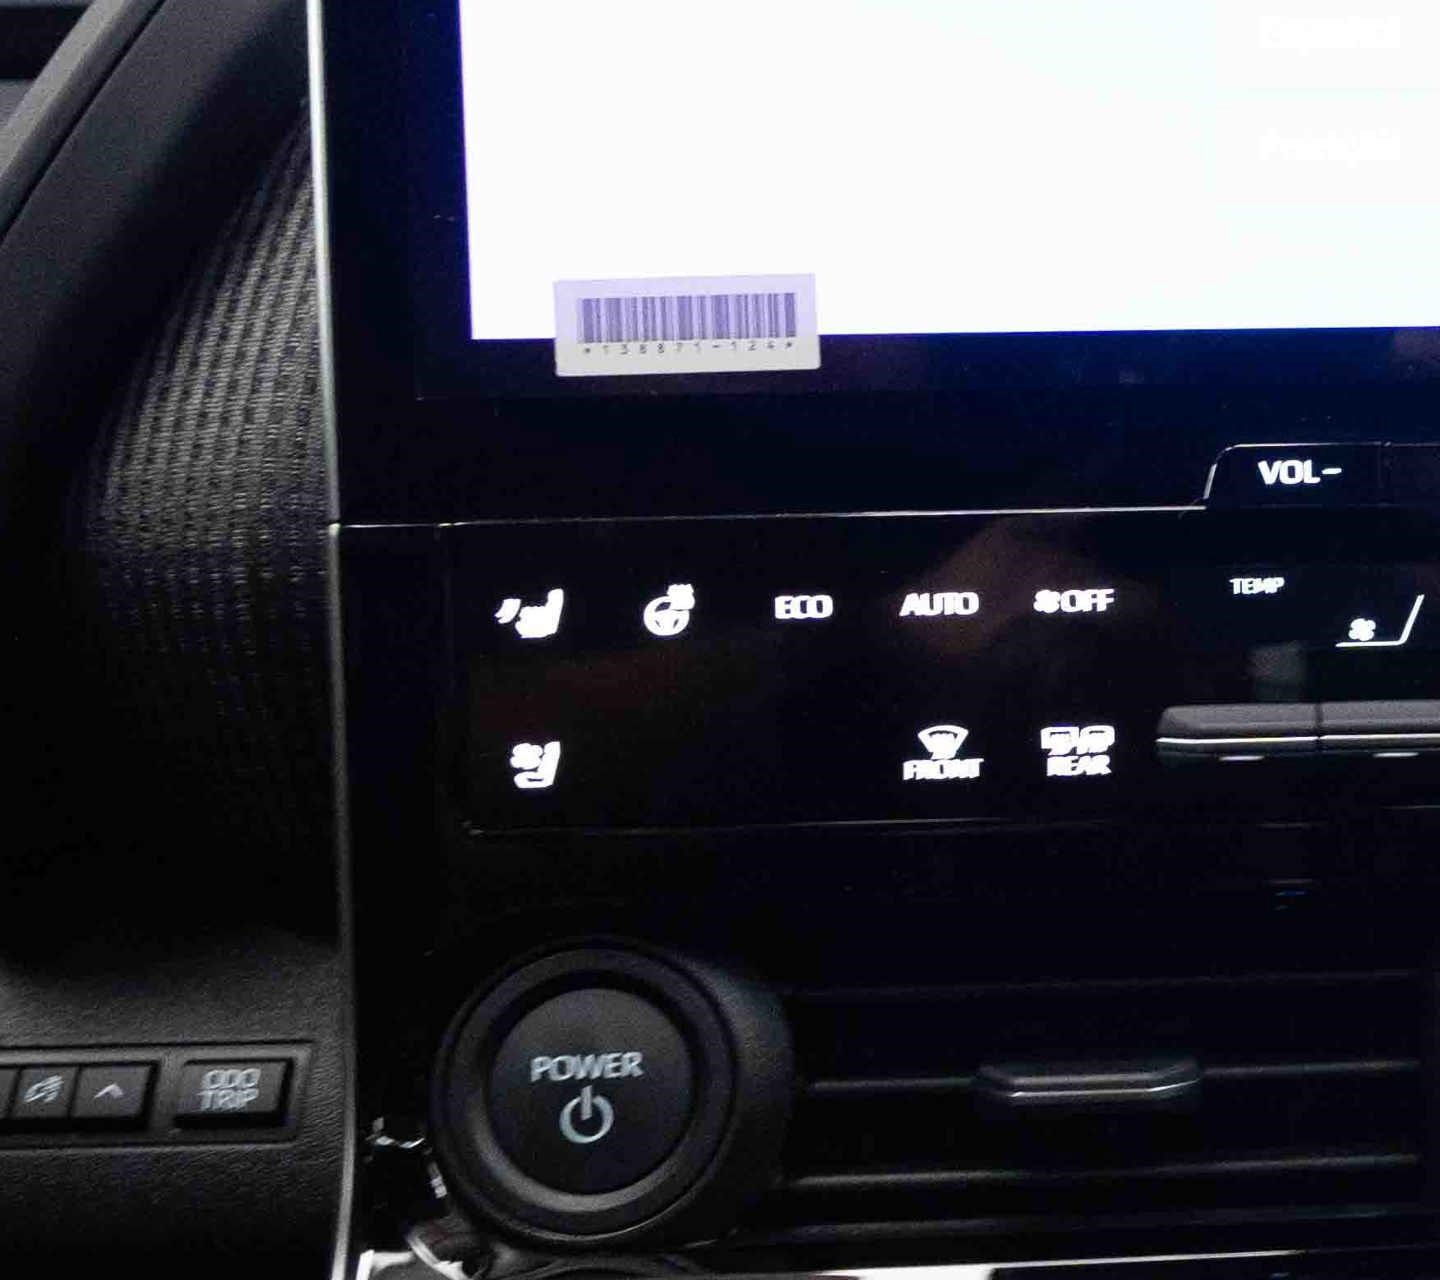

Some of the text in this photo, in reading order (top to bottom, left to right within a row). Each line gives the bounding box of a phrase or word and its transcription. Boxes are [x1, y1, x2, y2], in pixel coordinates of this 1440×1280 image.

[1229, 577, 1285, 594] TEMP
[775, 595, 833, 619] ECO
[899, 592, 979, 616] AUTO
[1059, 586, 1118, 615] OFF
[903, 757, 984, 780] FRONT
[1047, 754, 1111, 776] REAR
[531, 1052, 643, 1081] POWER
[196, 1088, 259, 1110] TRIP
